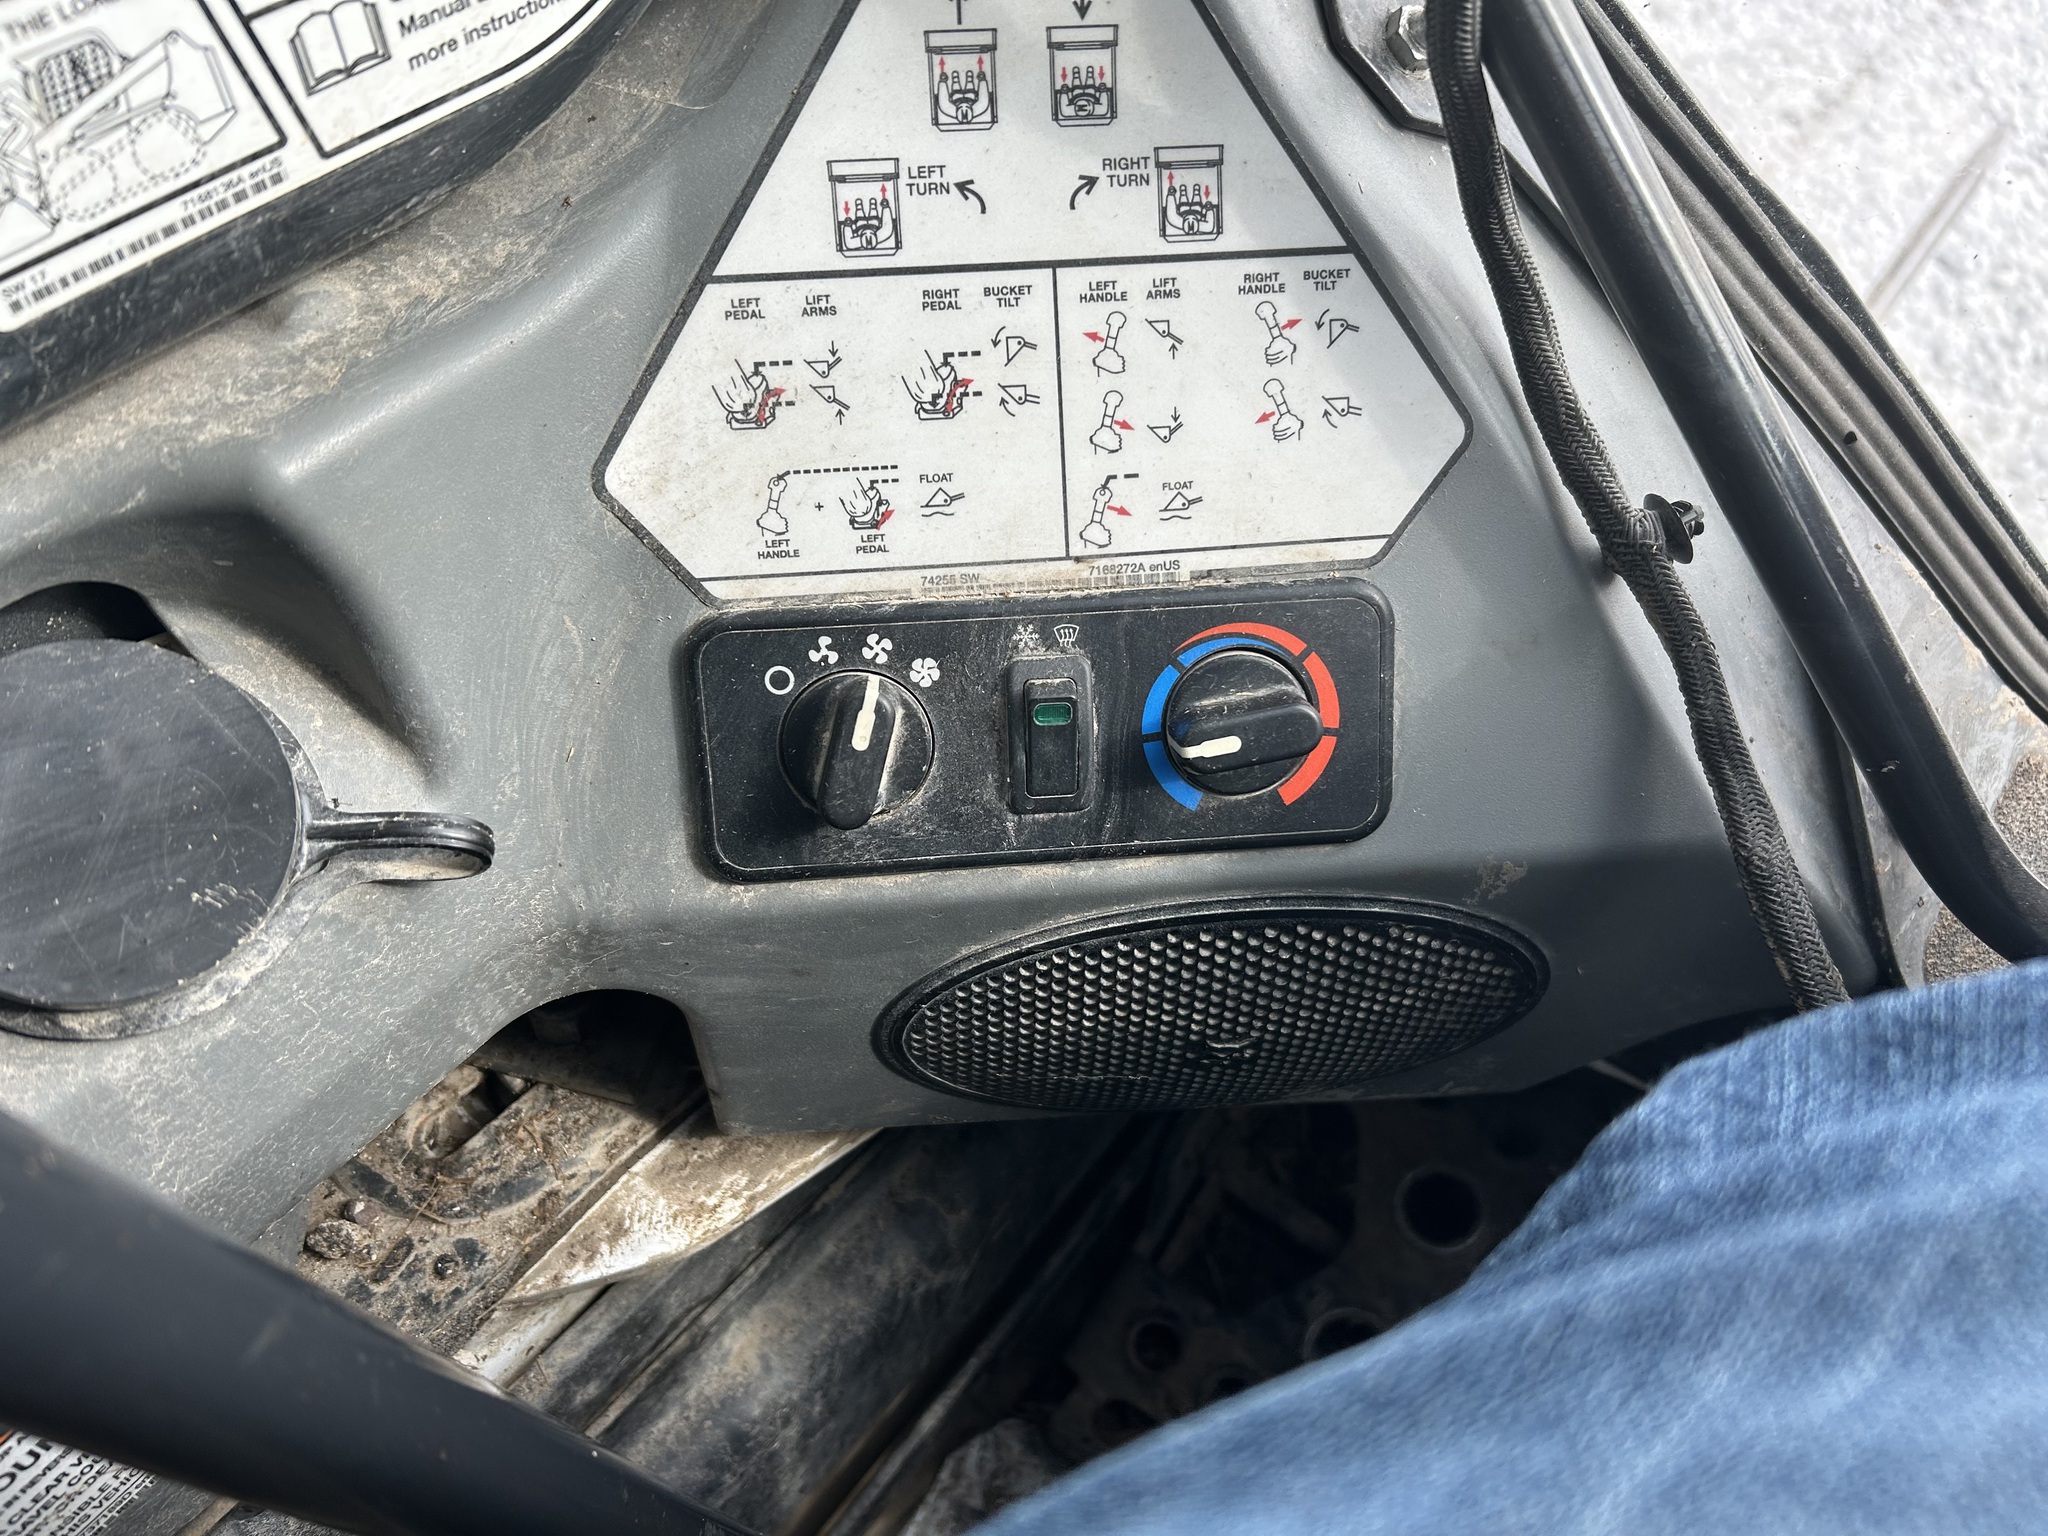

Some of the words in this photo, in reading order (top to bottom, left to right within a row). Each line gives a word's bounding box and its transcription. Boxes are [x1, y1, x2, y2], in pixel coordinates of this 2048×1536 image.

[408, 38, 459, 71] more
[461, 0, 561, 45] instructio
[1101, 155, 1152, 172] RIGHT
[907, 164, 947, 180] LEFT
[1105, 171, 1151, 189] TURN
[905, 181, 952, 197] TURN
[1243, 271, 1280, 284] RIGHT
[1303, 268, 1351, 281] BUCKET
[1088, 280, 1118, 292] LEFT
[1152, 277, 1178, 289] LIFT
[1238, 282, 1286, 296] HANDLE
[1313, 280, 1338, 292] TILT
[922, 288, 960, 300] RIGHT
[983, 284, 1033, 297] BUCKET
[1146, 288, 1181, 300] ARMS
[730, 297, 761, 309] LEFT
[805, 294, 831, 306] LIFT
[996, 296, 1021, 308] TILT
[1079, 291, 1128, 304] HANDLE
[801, 305, 838, 317] ARMS
[921, 299, 962, 312] PEDAL
[724, 308, 766, 321] PEDAL
[919, 472, 954, 484] FLOAT
[1162, 480, 1194, 491] FLOAT
[764, 538, 791, 549] LEFT
[860, 533, 886, 544] LEFT
[757, 549, 800, 560] HANDLE
[855, 544, 890, 555] PEDAL
[1088, 562, 1147, 577] 7168272A
[1148, 559, 1181, 573] enUS
[959, 573, 981, 585] SW
[8, 1472, 70, 1526] CLEAR
